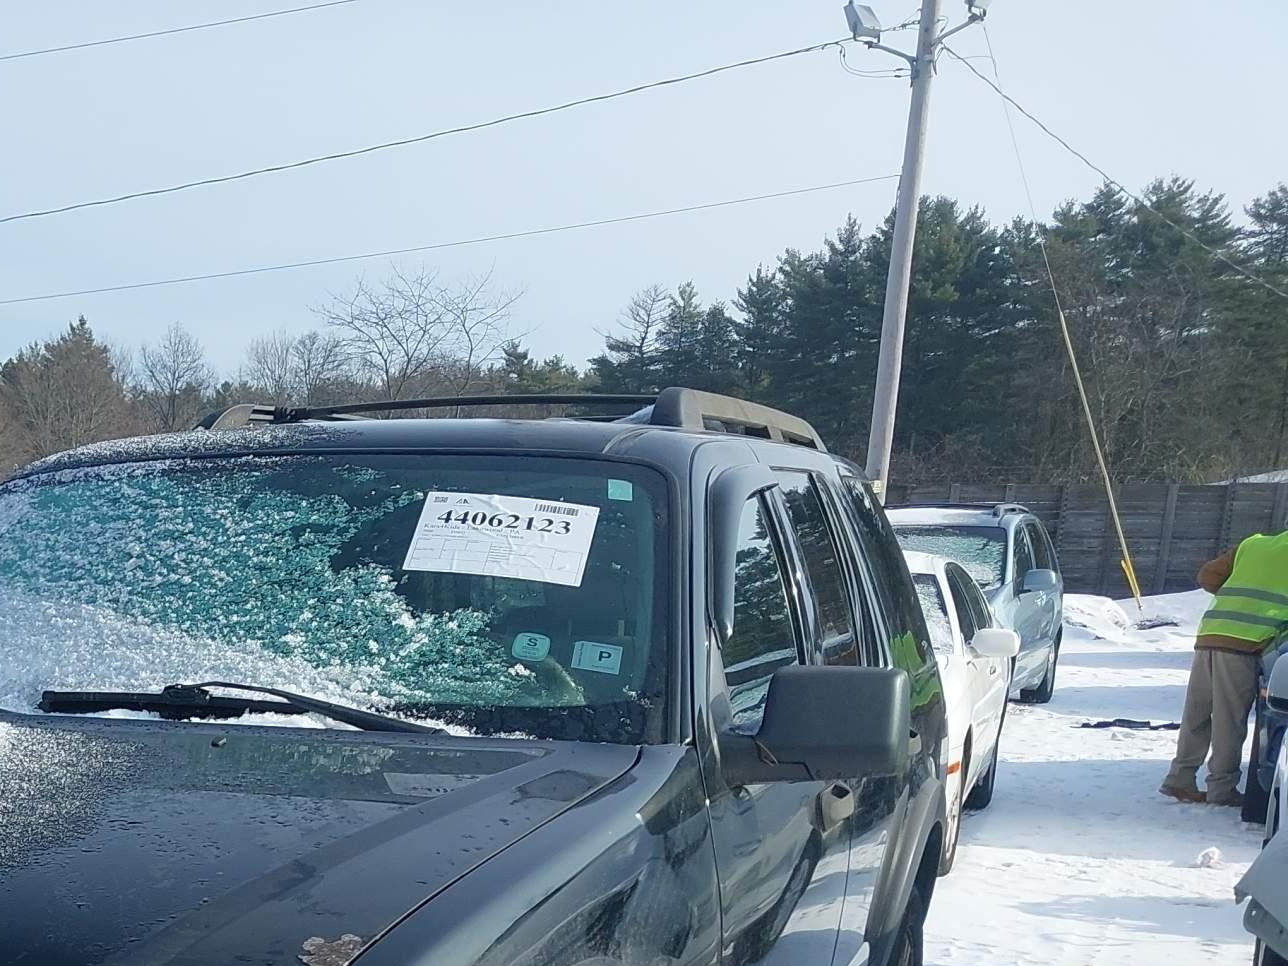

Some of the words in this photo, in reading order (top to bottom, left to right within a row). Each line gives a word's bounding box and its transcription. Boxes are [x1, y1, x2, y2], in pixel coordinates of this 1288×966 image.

[437, 510, 571, 535] 44062123
[527, 638, 538, 646] S
[599, 651, 611, 661] P
